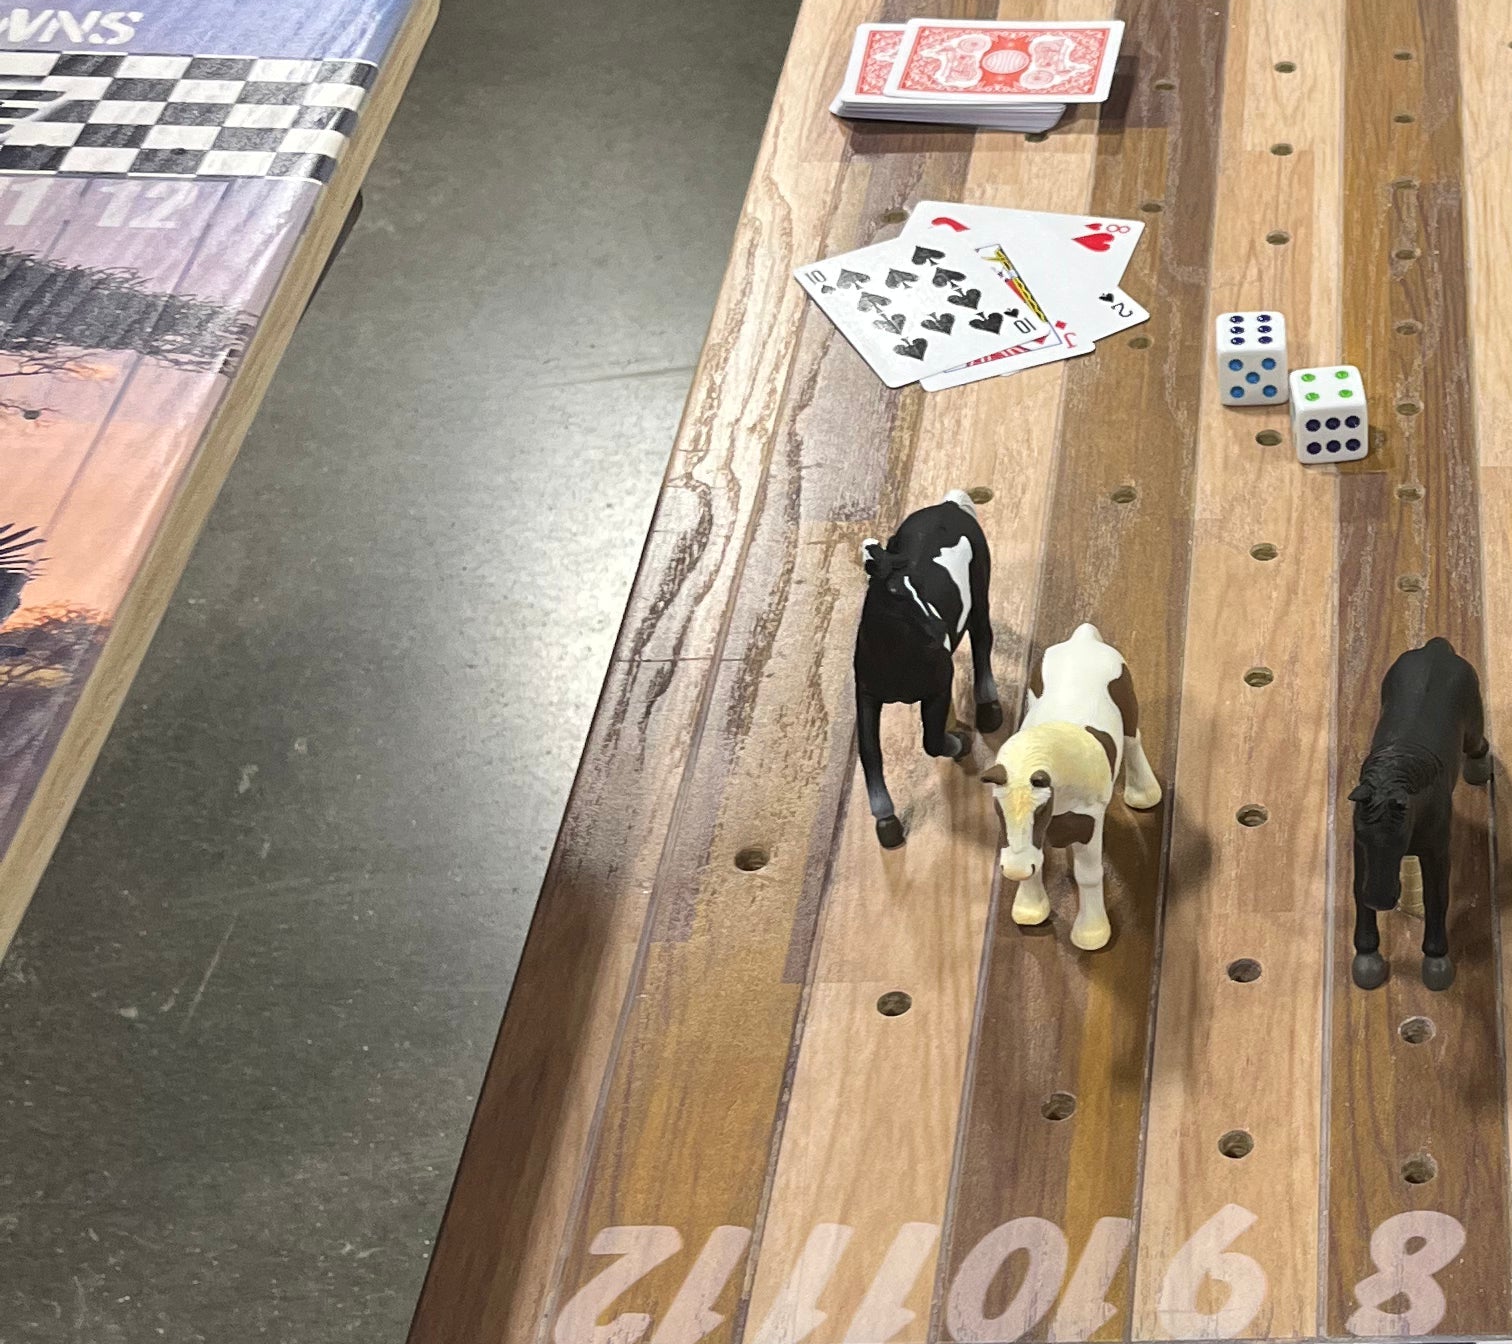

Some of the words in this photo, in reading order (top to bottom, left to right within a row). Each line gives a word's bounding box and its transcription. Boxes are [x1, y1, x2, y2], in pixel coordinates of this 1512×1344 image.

[97, 179, 198, 229] 12
[805, 270, 827, 285] 10
[1013, 317, 1037, 334] 10
[1110, 302, 1133, 318] 2
[1063, 332, 1078, 349] J
[946, 1216, 1134, 1344] 10
[1155, 1202, 1268, 1341] 9
[1344, 1210, 1467, 1336] 8
